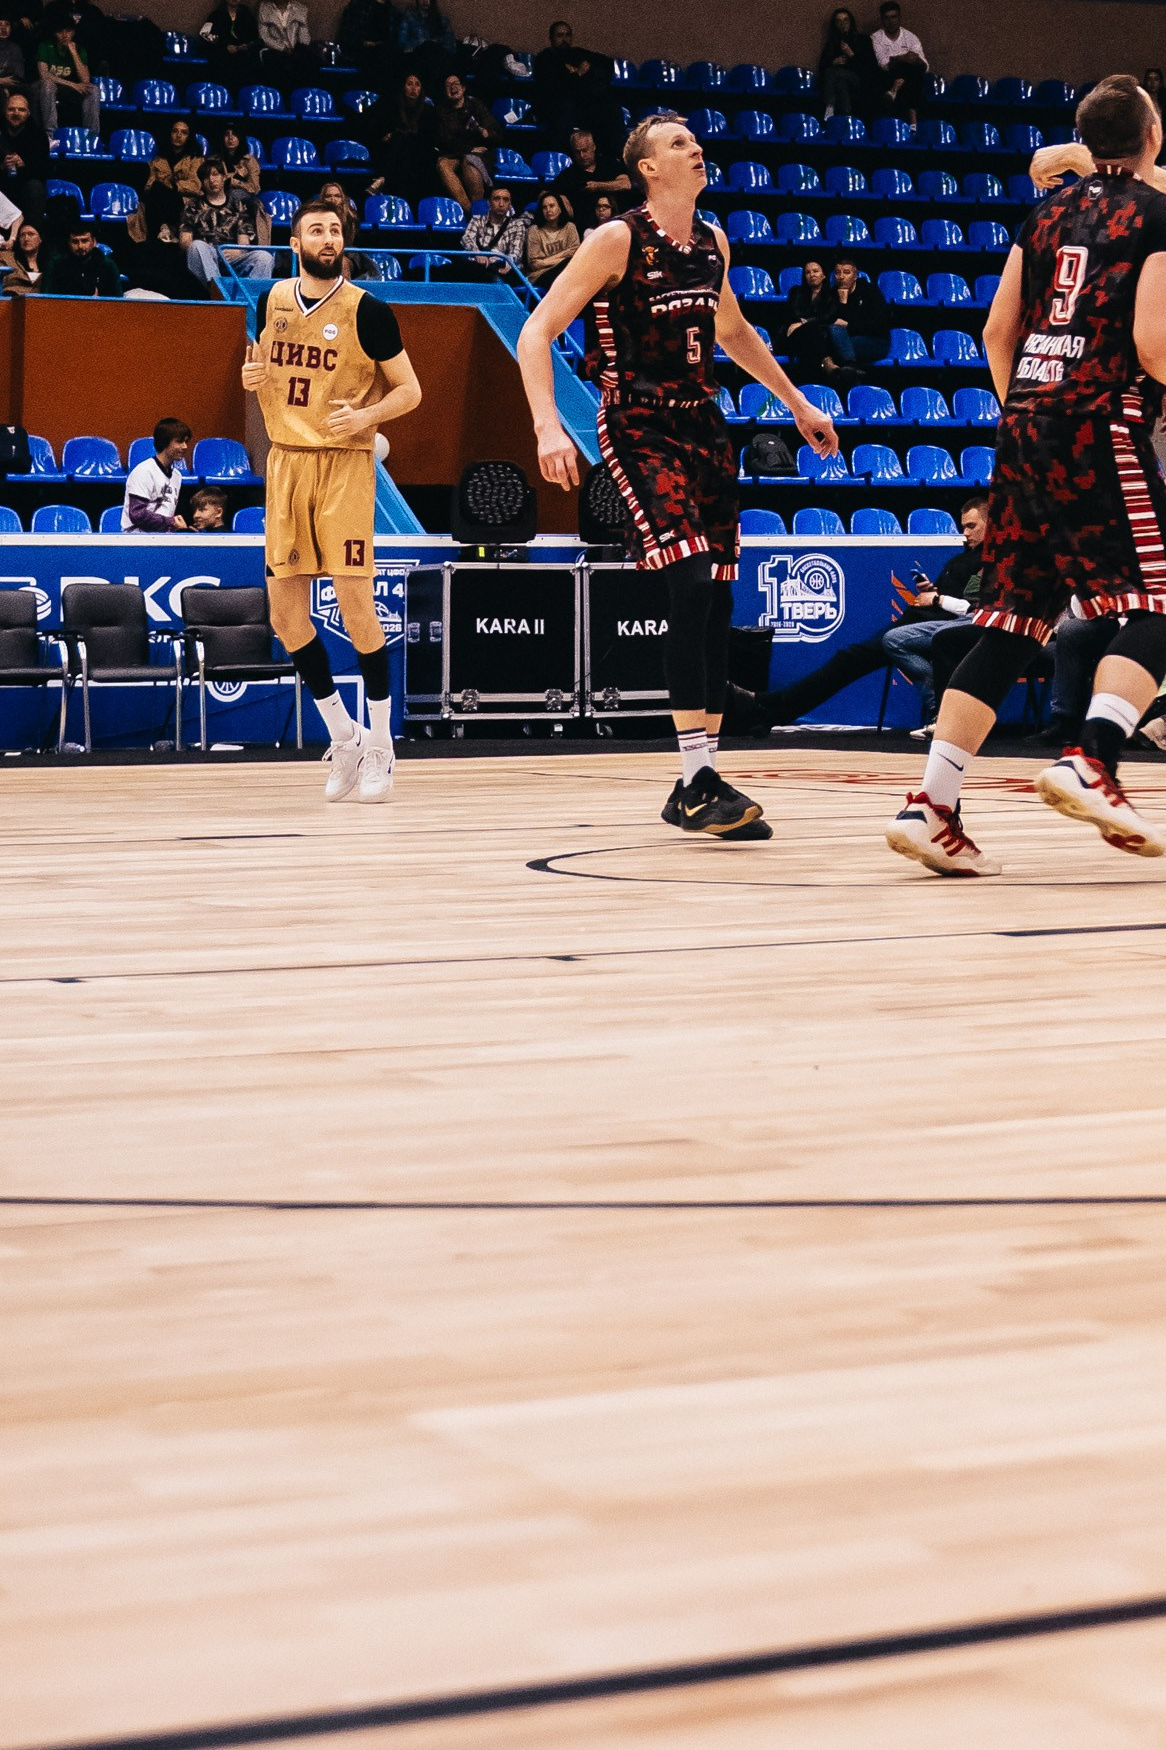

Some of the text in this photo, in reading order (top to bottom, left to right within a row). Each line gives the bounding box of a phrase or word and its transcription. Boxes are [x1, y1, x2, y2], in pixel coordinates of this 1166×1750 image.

[1049, 245, 1089, 326] 9
[270, 340, 338, 371] ЦИВС
[686, 326, 701, 364] 5
[287, 376, 311, 408] 13
[343, 539, 366, 567] 13
[780, 602, 837, 620] ТВЕРЬ
[381, 623, 402, 633] 026
[476, 618, 531, 635] KARA
[617, 620, 669, 636] KARA
